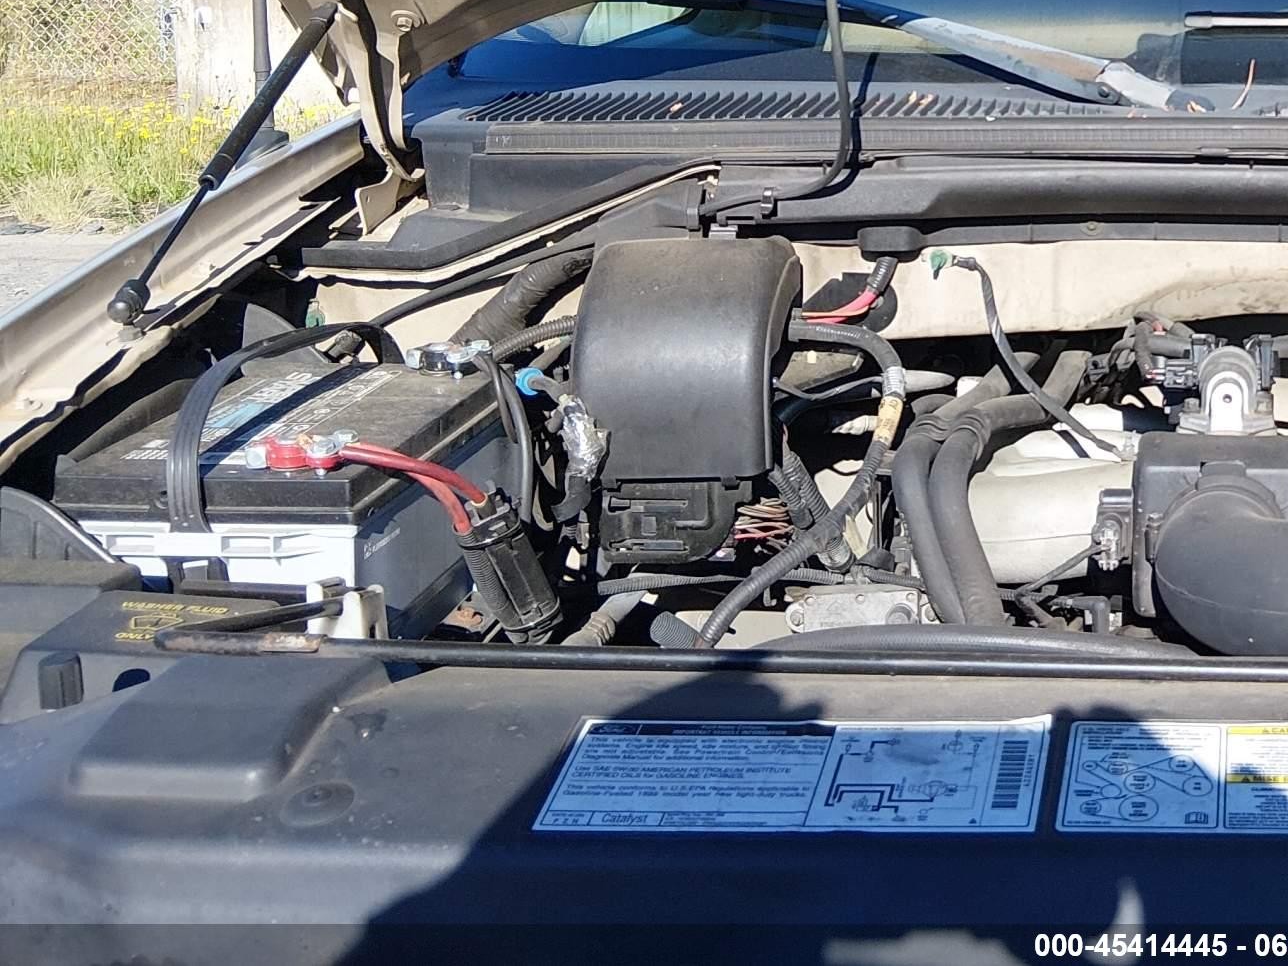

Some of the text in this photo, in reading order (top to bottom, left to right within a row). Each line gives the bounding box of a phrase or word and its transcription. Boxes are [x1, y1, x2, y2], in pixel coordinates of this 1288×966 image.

[121, 601, 230, 615] WASHER FLUID
[114, 632, 155, 641] ONLY
[601, 813, 648, 825] Catalyst
